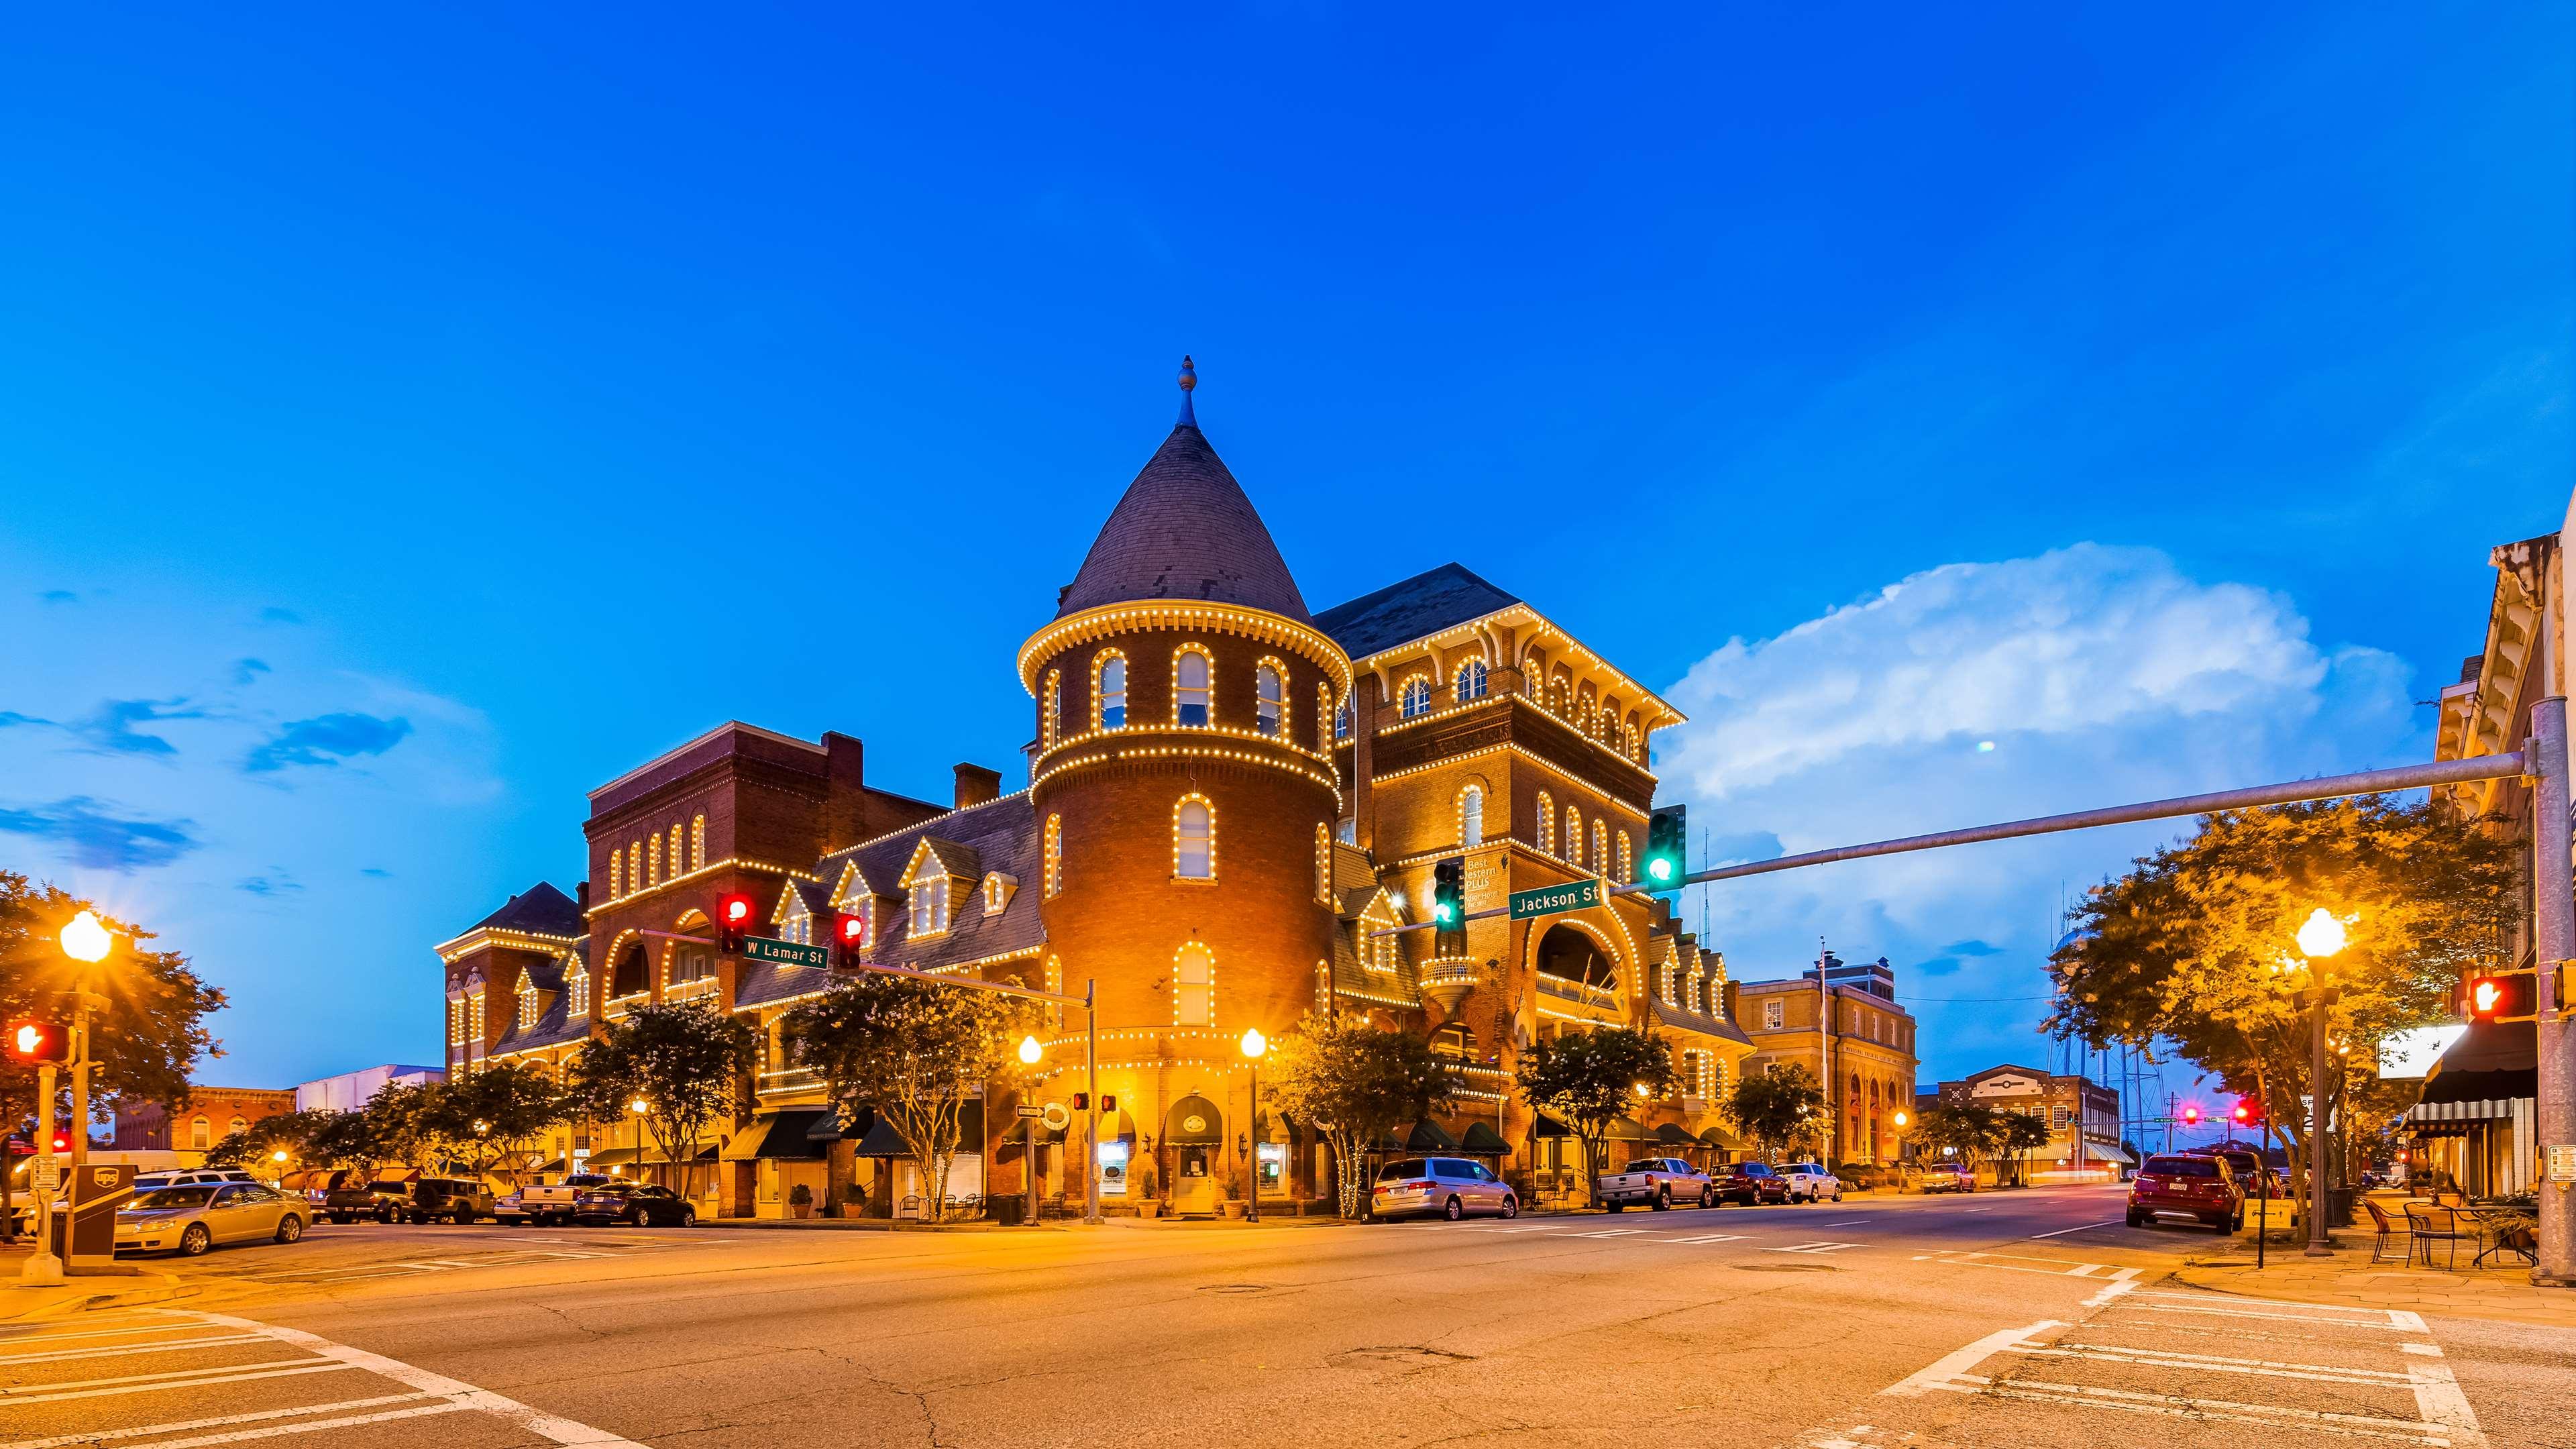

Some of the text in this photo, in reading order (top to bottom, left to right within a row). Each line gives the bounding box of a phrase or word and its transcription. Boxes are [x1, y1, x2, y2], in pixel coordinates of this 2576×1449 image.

[1468, 858, 1488, 870] Best
[1466, 878, 1489, 890] PLUS
[1517, 885, 1599, 913] Jackson St
[747, 941, 823, 964] W Lamar St
[97, 1173, 117, 1185] ups
